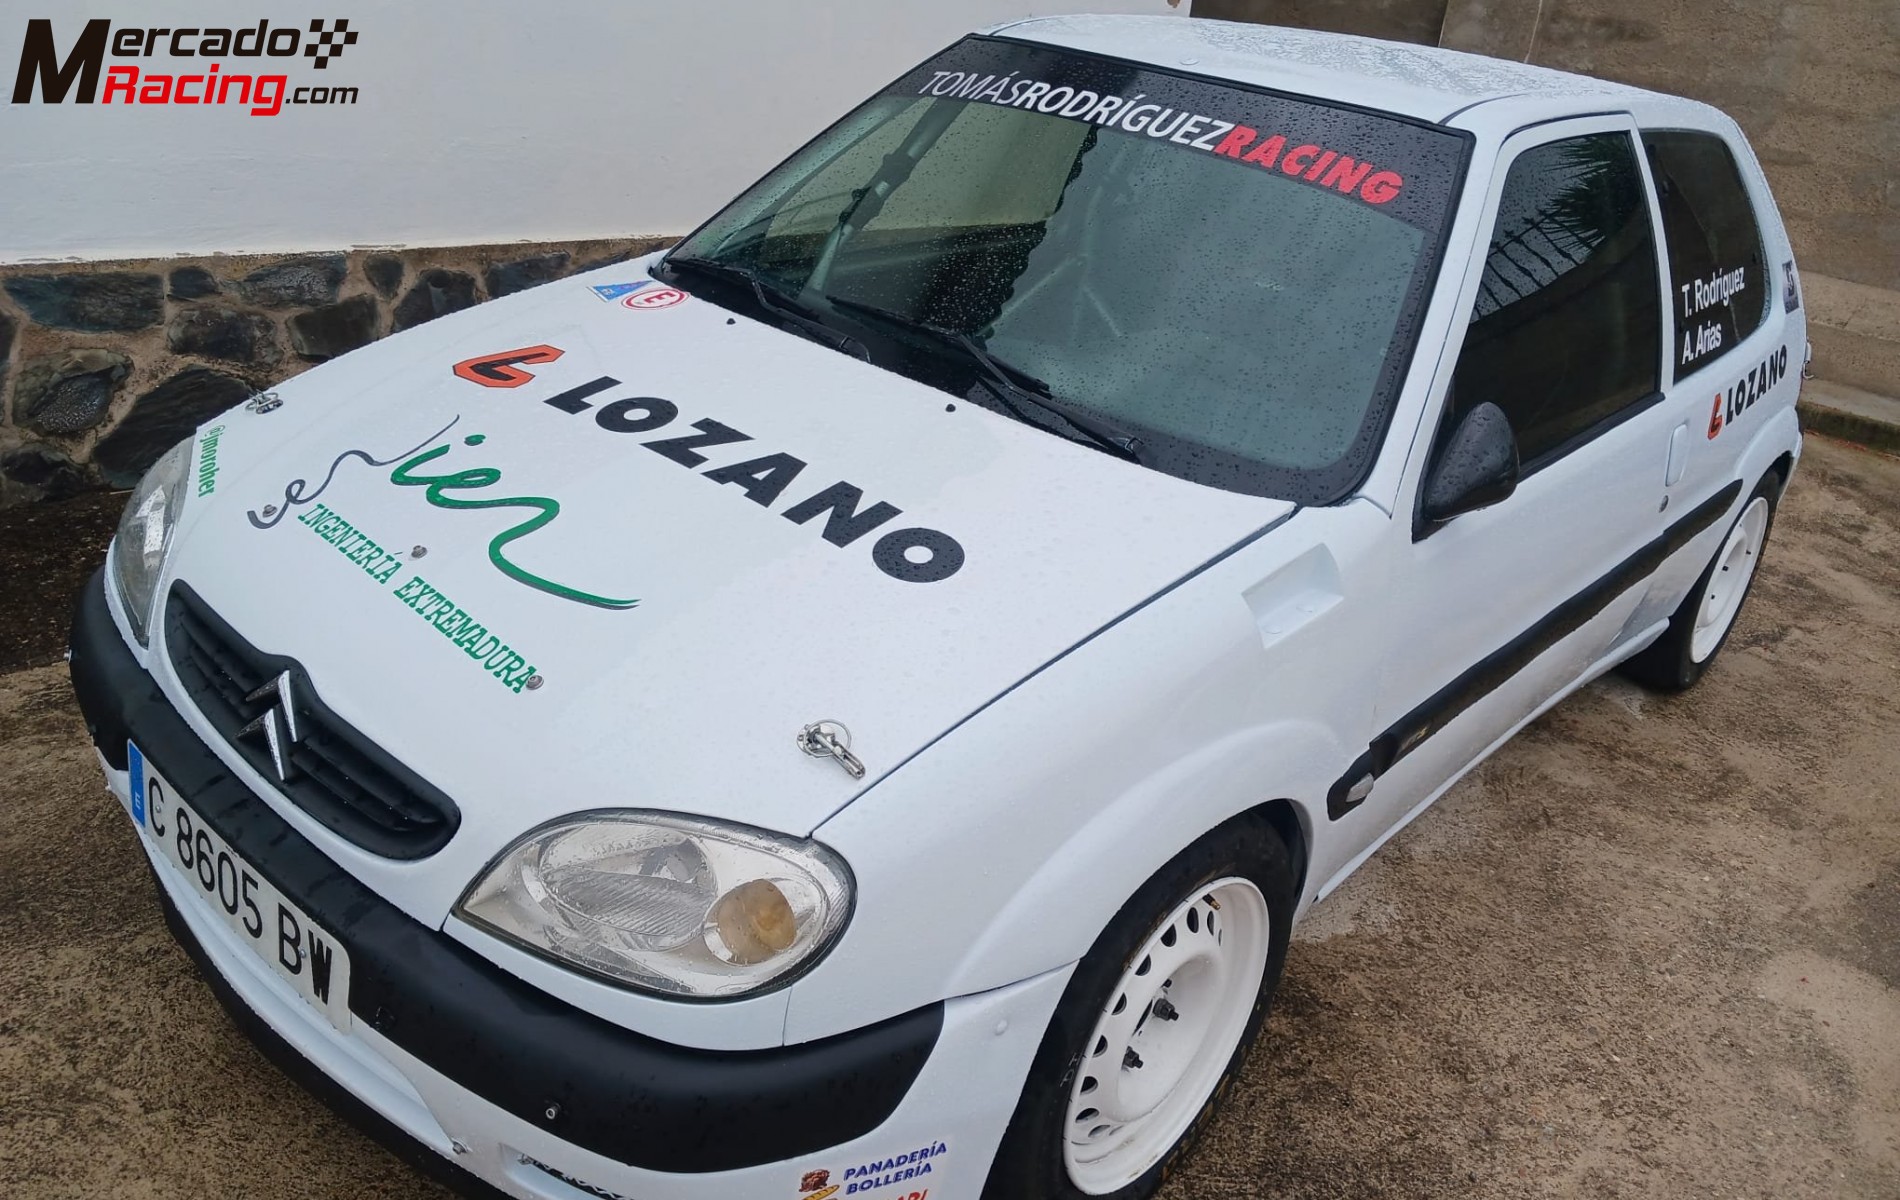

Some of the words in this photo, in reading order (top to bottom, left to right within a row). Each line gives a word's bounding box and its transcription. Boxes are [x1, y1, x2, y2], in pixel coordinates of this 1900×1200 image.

[1681, 283, 1692, 318] T.
[1694, 266, 1745, 313] Rodríguez
[1681, 330, 1694, 365] A.
[1695, 320, 1722, 359] Arias
[1725, 344, 1788, 426] LOZANO
[542, 375, 965, 583] LOZANO
[298, 504, 403, 584] INGENIERÍA
[393, 576, 539, 693] EXTREMADURA
[148, 776, 165, 837] C
[176, 807, 262, 938] 8605
[278, 902, 332, 1005] BW
[843, 1141, 947, 1181] PANADERÍA
[846, 1161, 932, 1195] BOLLERÍA
